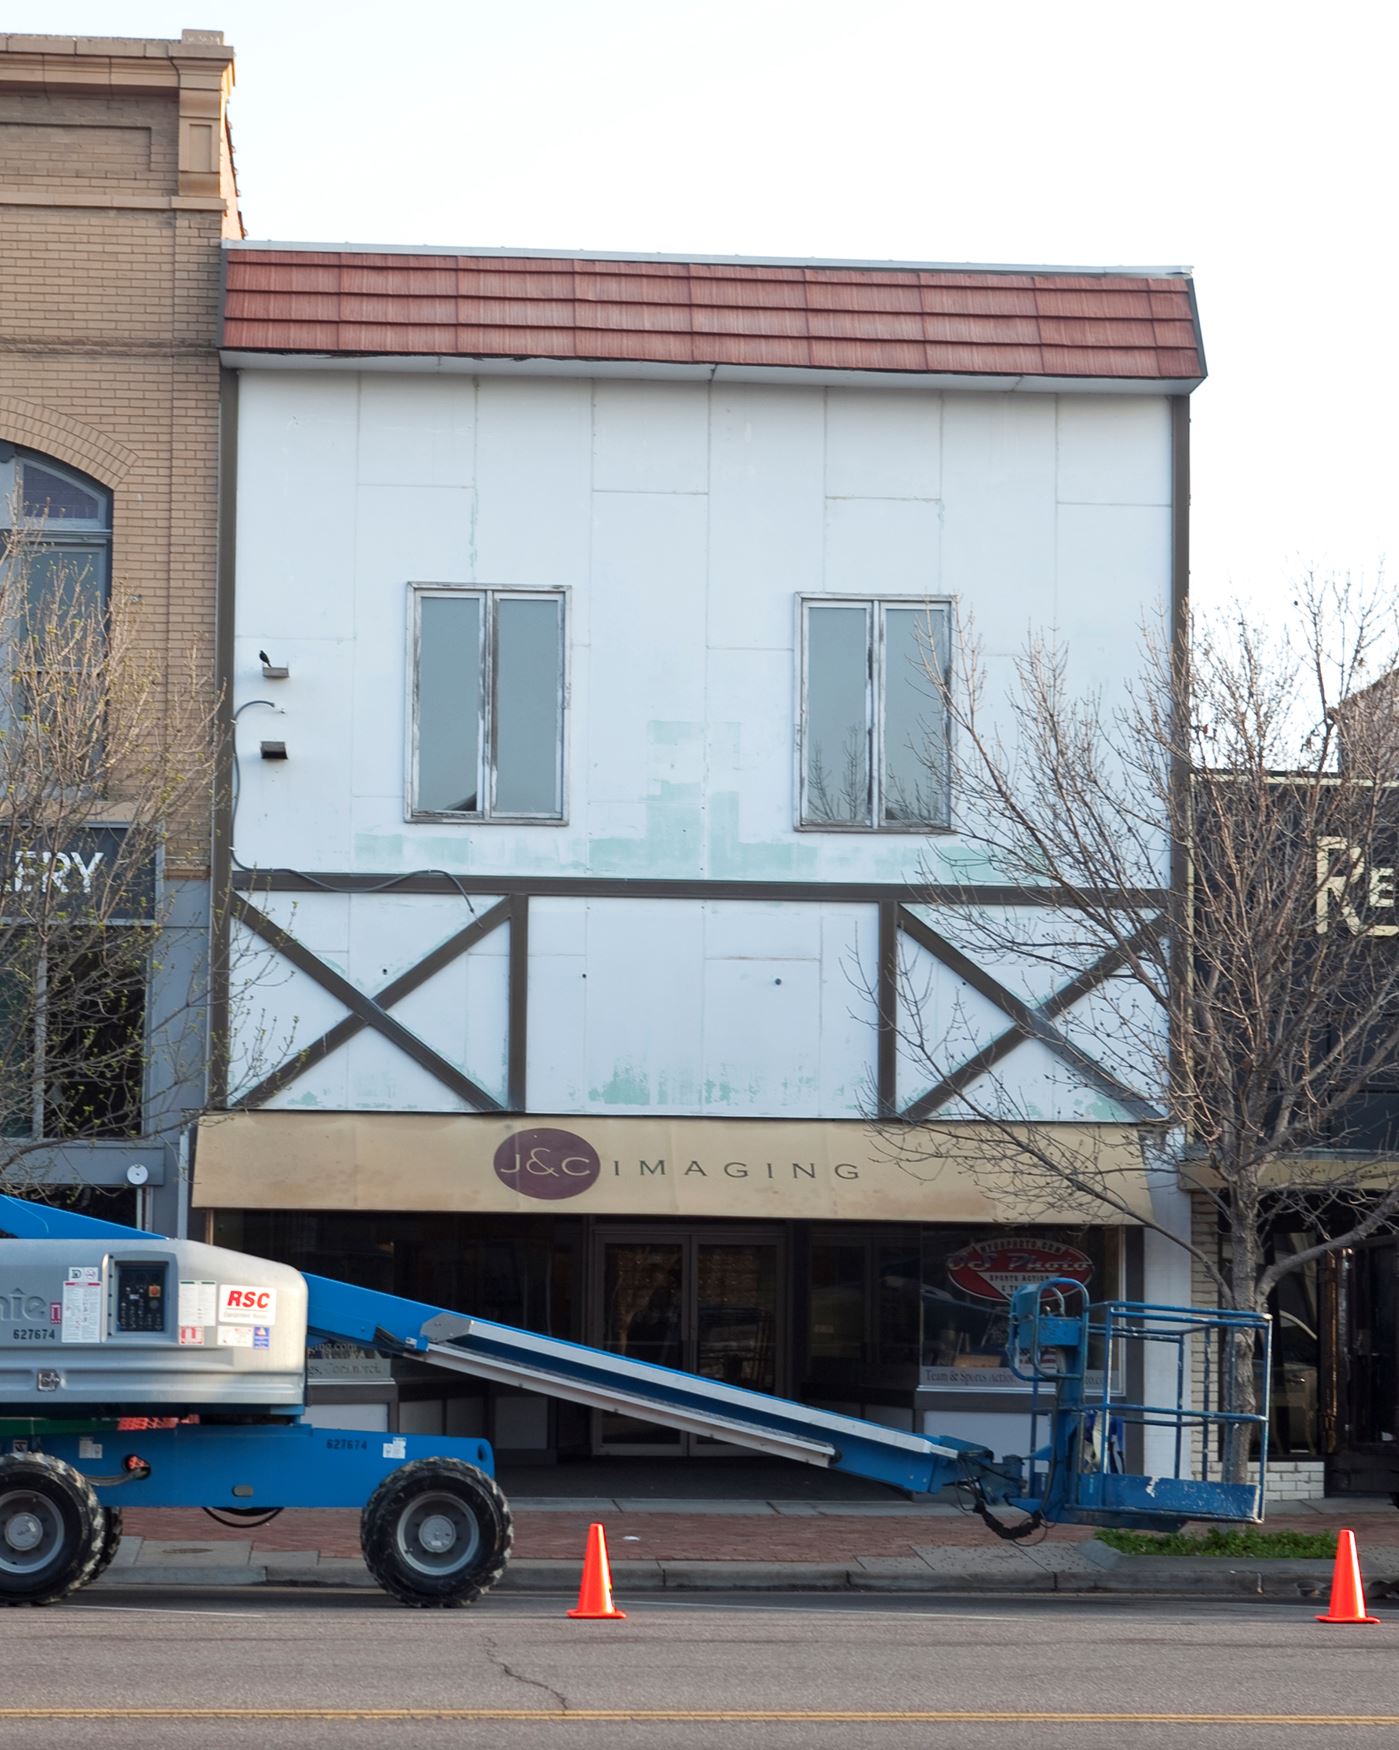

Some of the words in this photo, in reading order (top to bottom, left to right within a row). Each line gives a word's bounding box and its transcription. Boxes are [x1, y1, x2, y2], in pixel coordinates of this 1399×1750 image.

[0, 851, 104, 893] ERY
[499, 1147, 591, 1178] J&C
[614, 1159, 860, 1180] IMAGING
[227, 1290, 271, 1308] RSC
[13, 1328, 56, 1340] 627674
[326, 1439, 368, 1450] 627674
